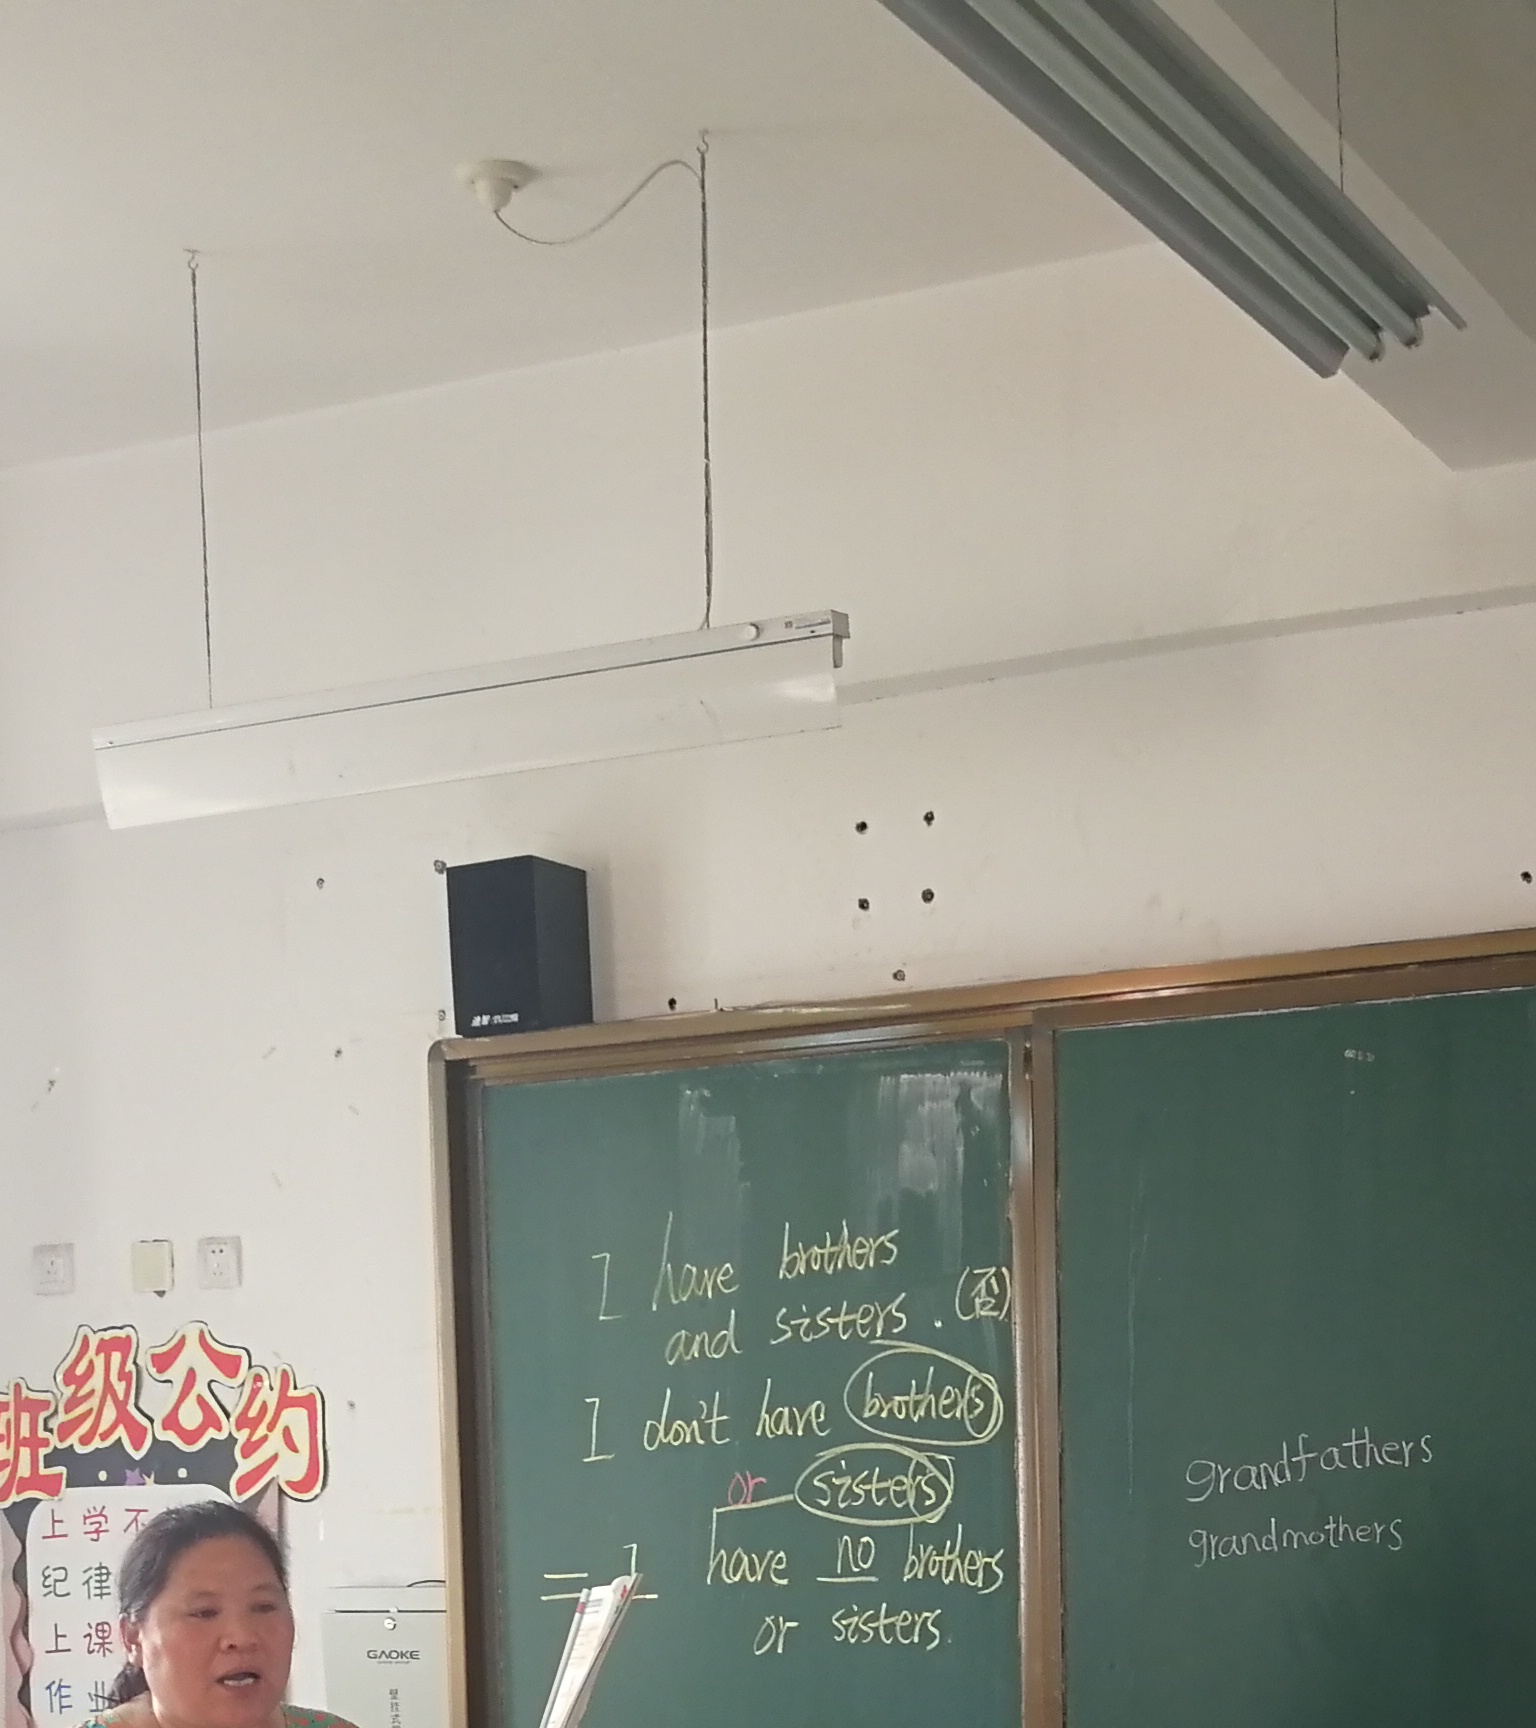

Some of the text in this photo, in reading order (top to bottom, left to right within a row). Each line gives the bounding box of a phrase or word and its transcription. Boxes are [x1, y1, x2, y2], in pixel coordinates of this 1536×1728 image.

[592, 1210, 900, 1320] I have brothers
[665, 1310, 742, 1366] and
[582, 1366, 987, 1462] I don't have brothers
[727, 1460, 938, 1508] or sisters
[1185, 1426, 1434, 1503] grandfathers
[706, 1509, 789, 1586] have
[835, 1534, 876, 1574] no
[903, 1524, 1005, 1595] brothers
[1187, 1515, 1404, 1568] grandmothers
[41, 1561, 112, 1601] 纪律
[44, 1620, 114, 1658] 上课
[366, 1649, 421, 1660] GAOKE
[753, 1616, 799, 1656] or
